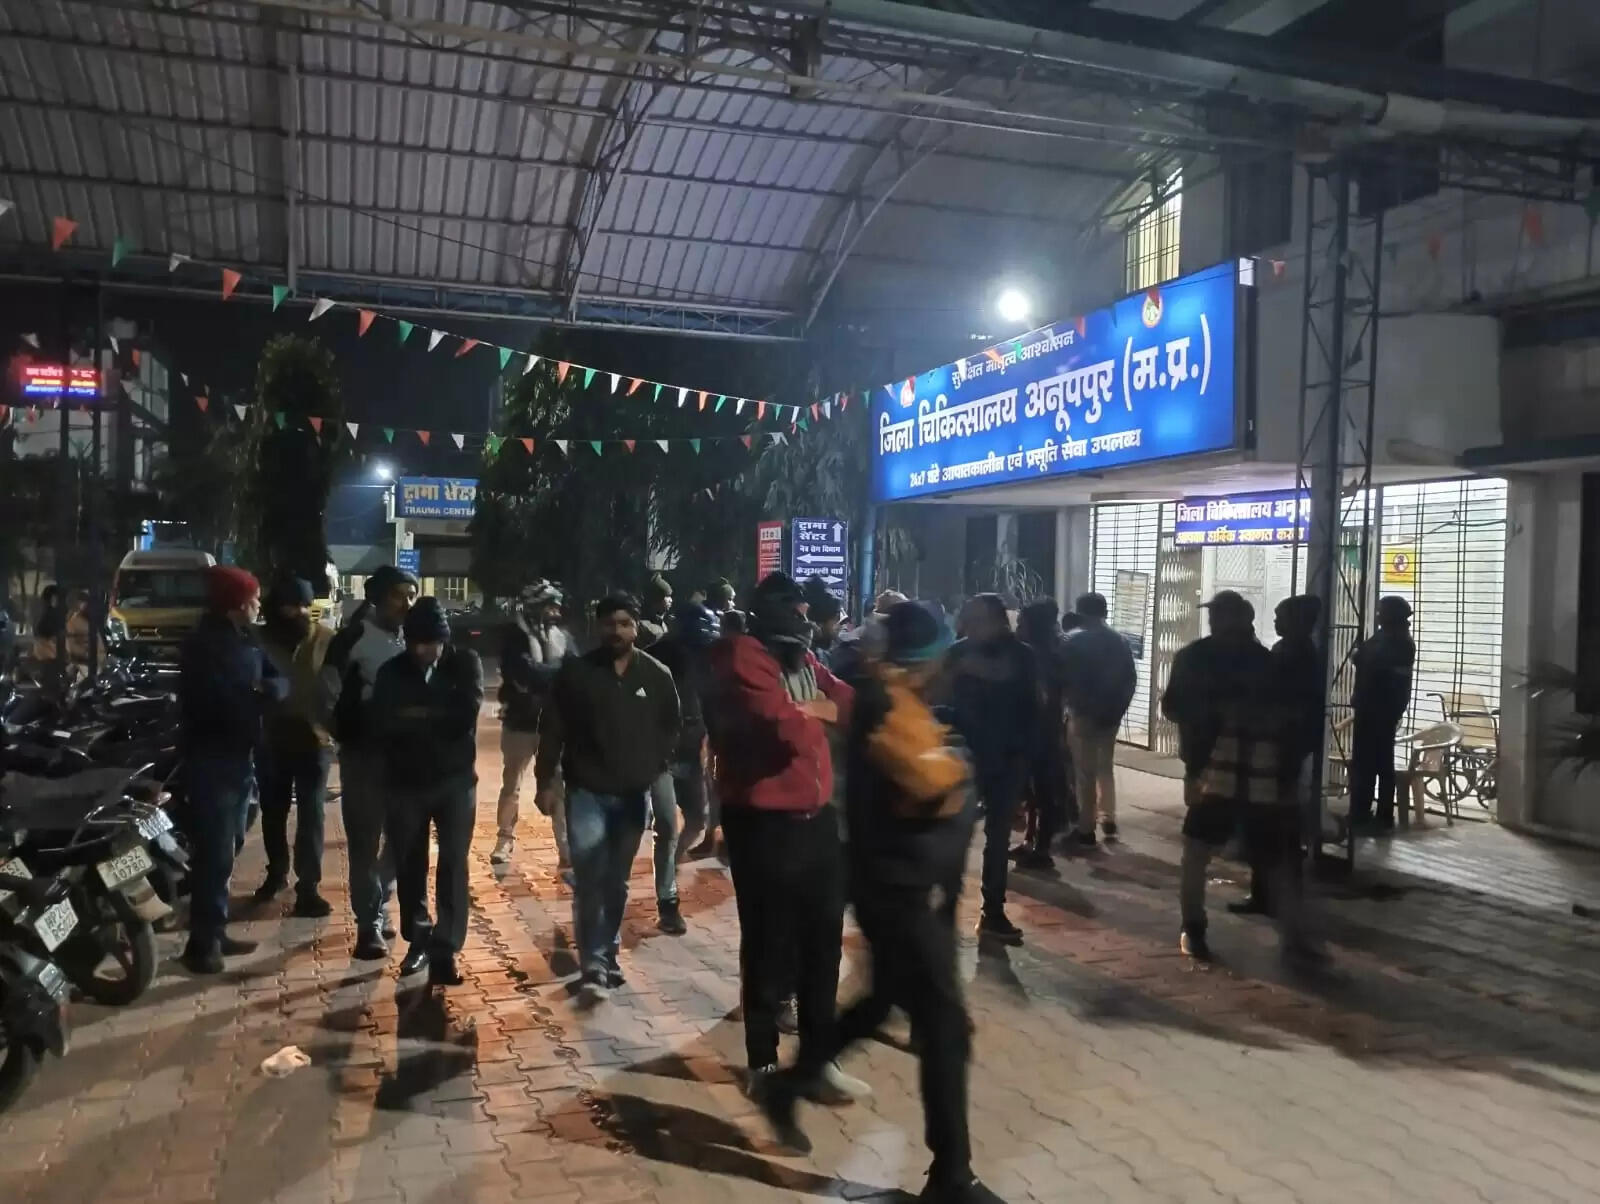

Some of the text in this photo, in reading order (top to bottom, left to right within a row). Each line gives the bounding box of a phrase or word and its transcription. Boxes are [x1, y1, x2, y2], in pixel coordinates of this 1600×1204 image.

[880, 313, 1212, 455] जिला चिकित्सालय अनूपपुर (म.प्र.)
[952, 362, 983, 390] सुक्षित
[942, 451, 1004, 481] आपातकालीन
[1007, 445, 1023, 472] एवं
[1026, 438, 1058, 472] प्रसूति
[1062, 435, 1087, 460] सेवा
[1091, 428, 1142, 454] उपलब्ध
[404, 507, 440, 515] TRAUMA
[1177, 503, 1205, 522] जिला
[1207, 500, 1273, 520] चिकित्सालय
